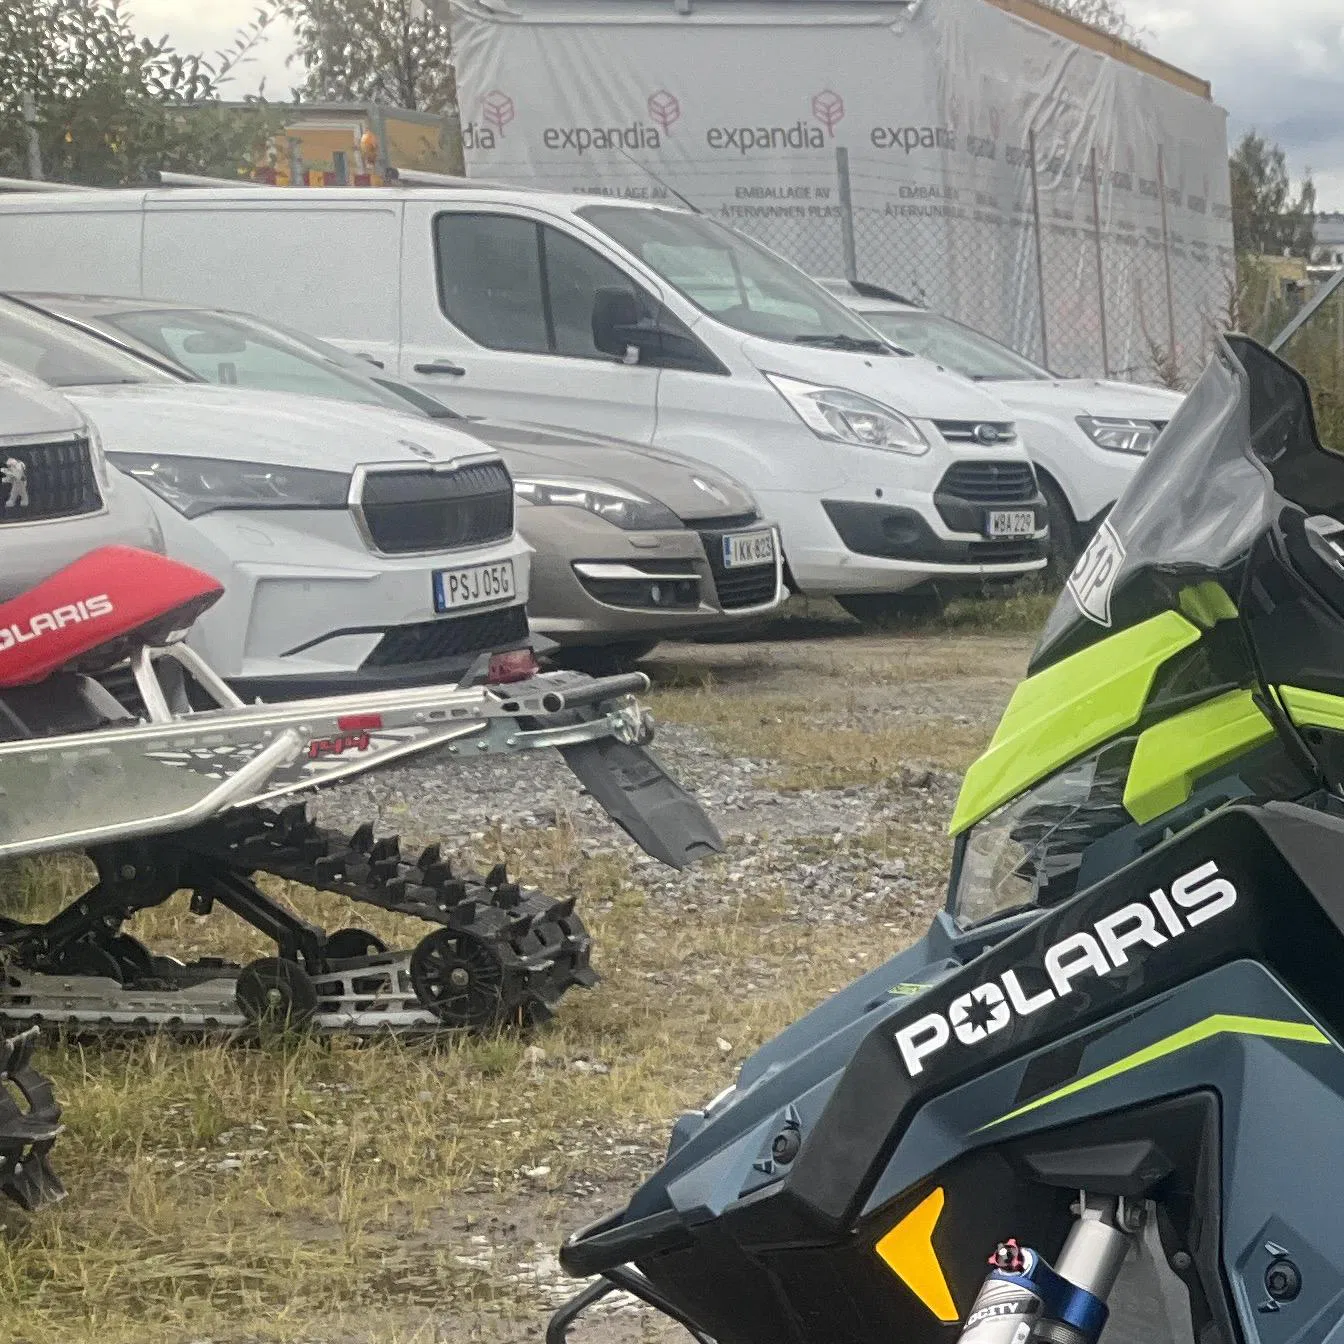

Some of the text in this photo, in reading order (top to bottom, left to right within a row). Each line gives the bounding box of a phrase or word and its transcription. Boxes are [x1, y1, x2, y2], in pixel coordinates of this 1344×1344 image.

[543, 122, 661, 154] expandia
[706, 121, 825, 154] expandia
[448, 571, 480, 603] PSJ
[0, 593, 114, 652] OLARIS
[894, 859, 1238, 1078] POLARIS
